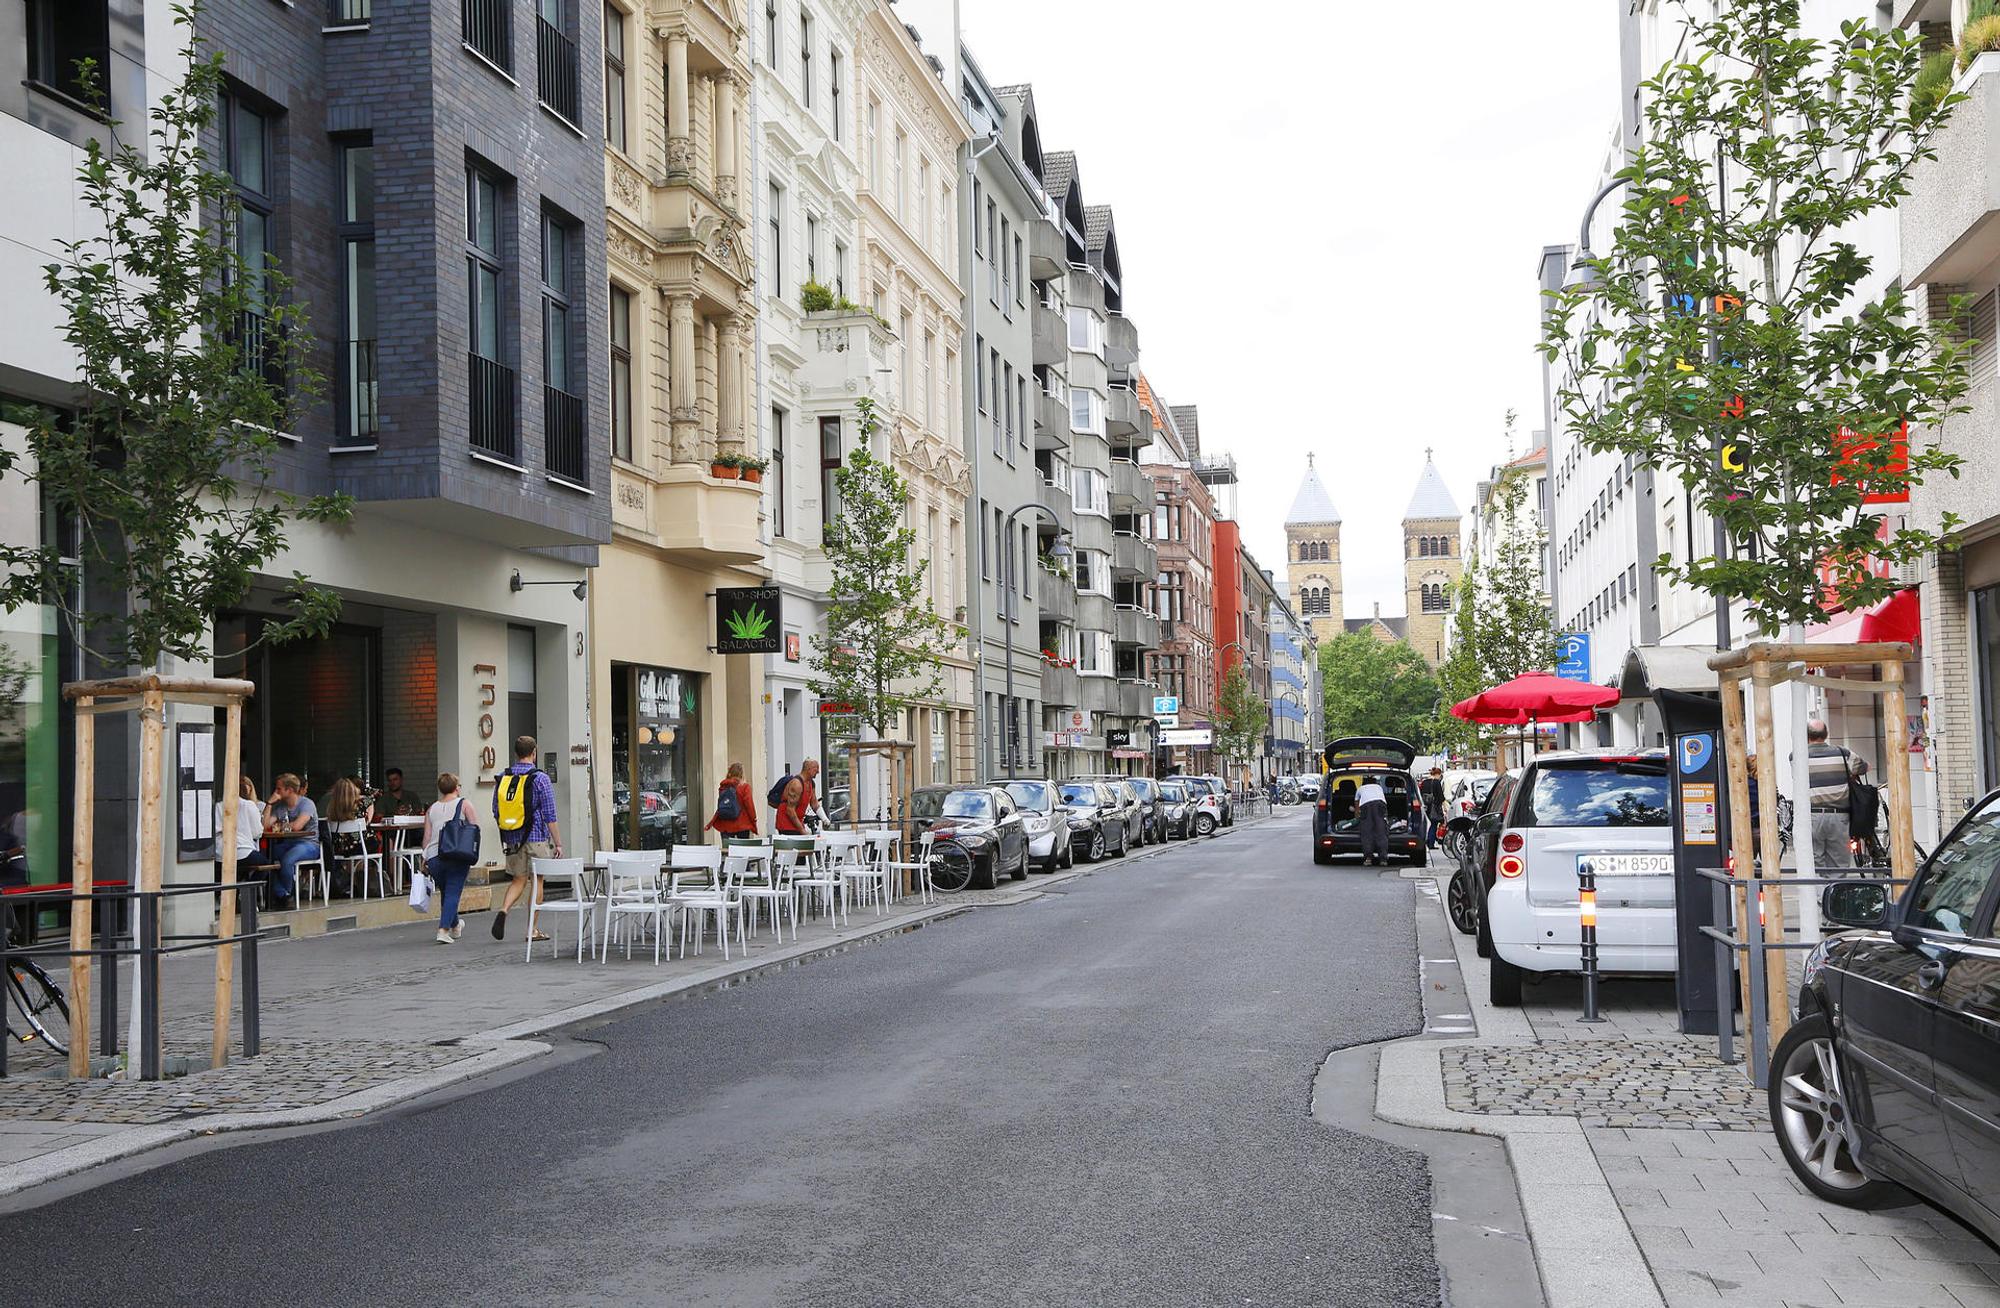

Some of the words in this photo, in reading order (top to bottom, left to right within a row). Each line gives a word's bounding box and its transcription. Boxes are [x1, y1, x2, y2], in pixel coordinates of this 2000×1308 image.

[576, 631, 584, 656] 3
[720, 638, 776, 650] GALACTIC
[1568, 642, 1580, 657] P
[1113, 733, 1128, 742] sky
[1617, 857, 1627, 871] M
